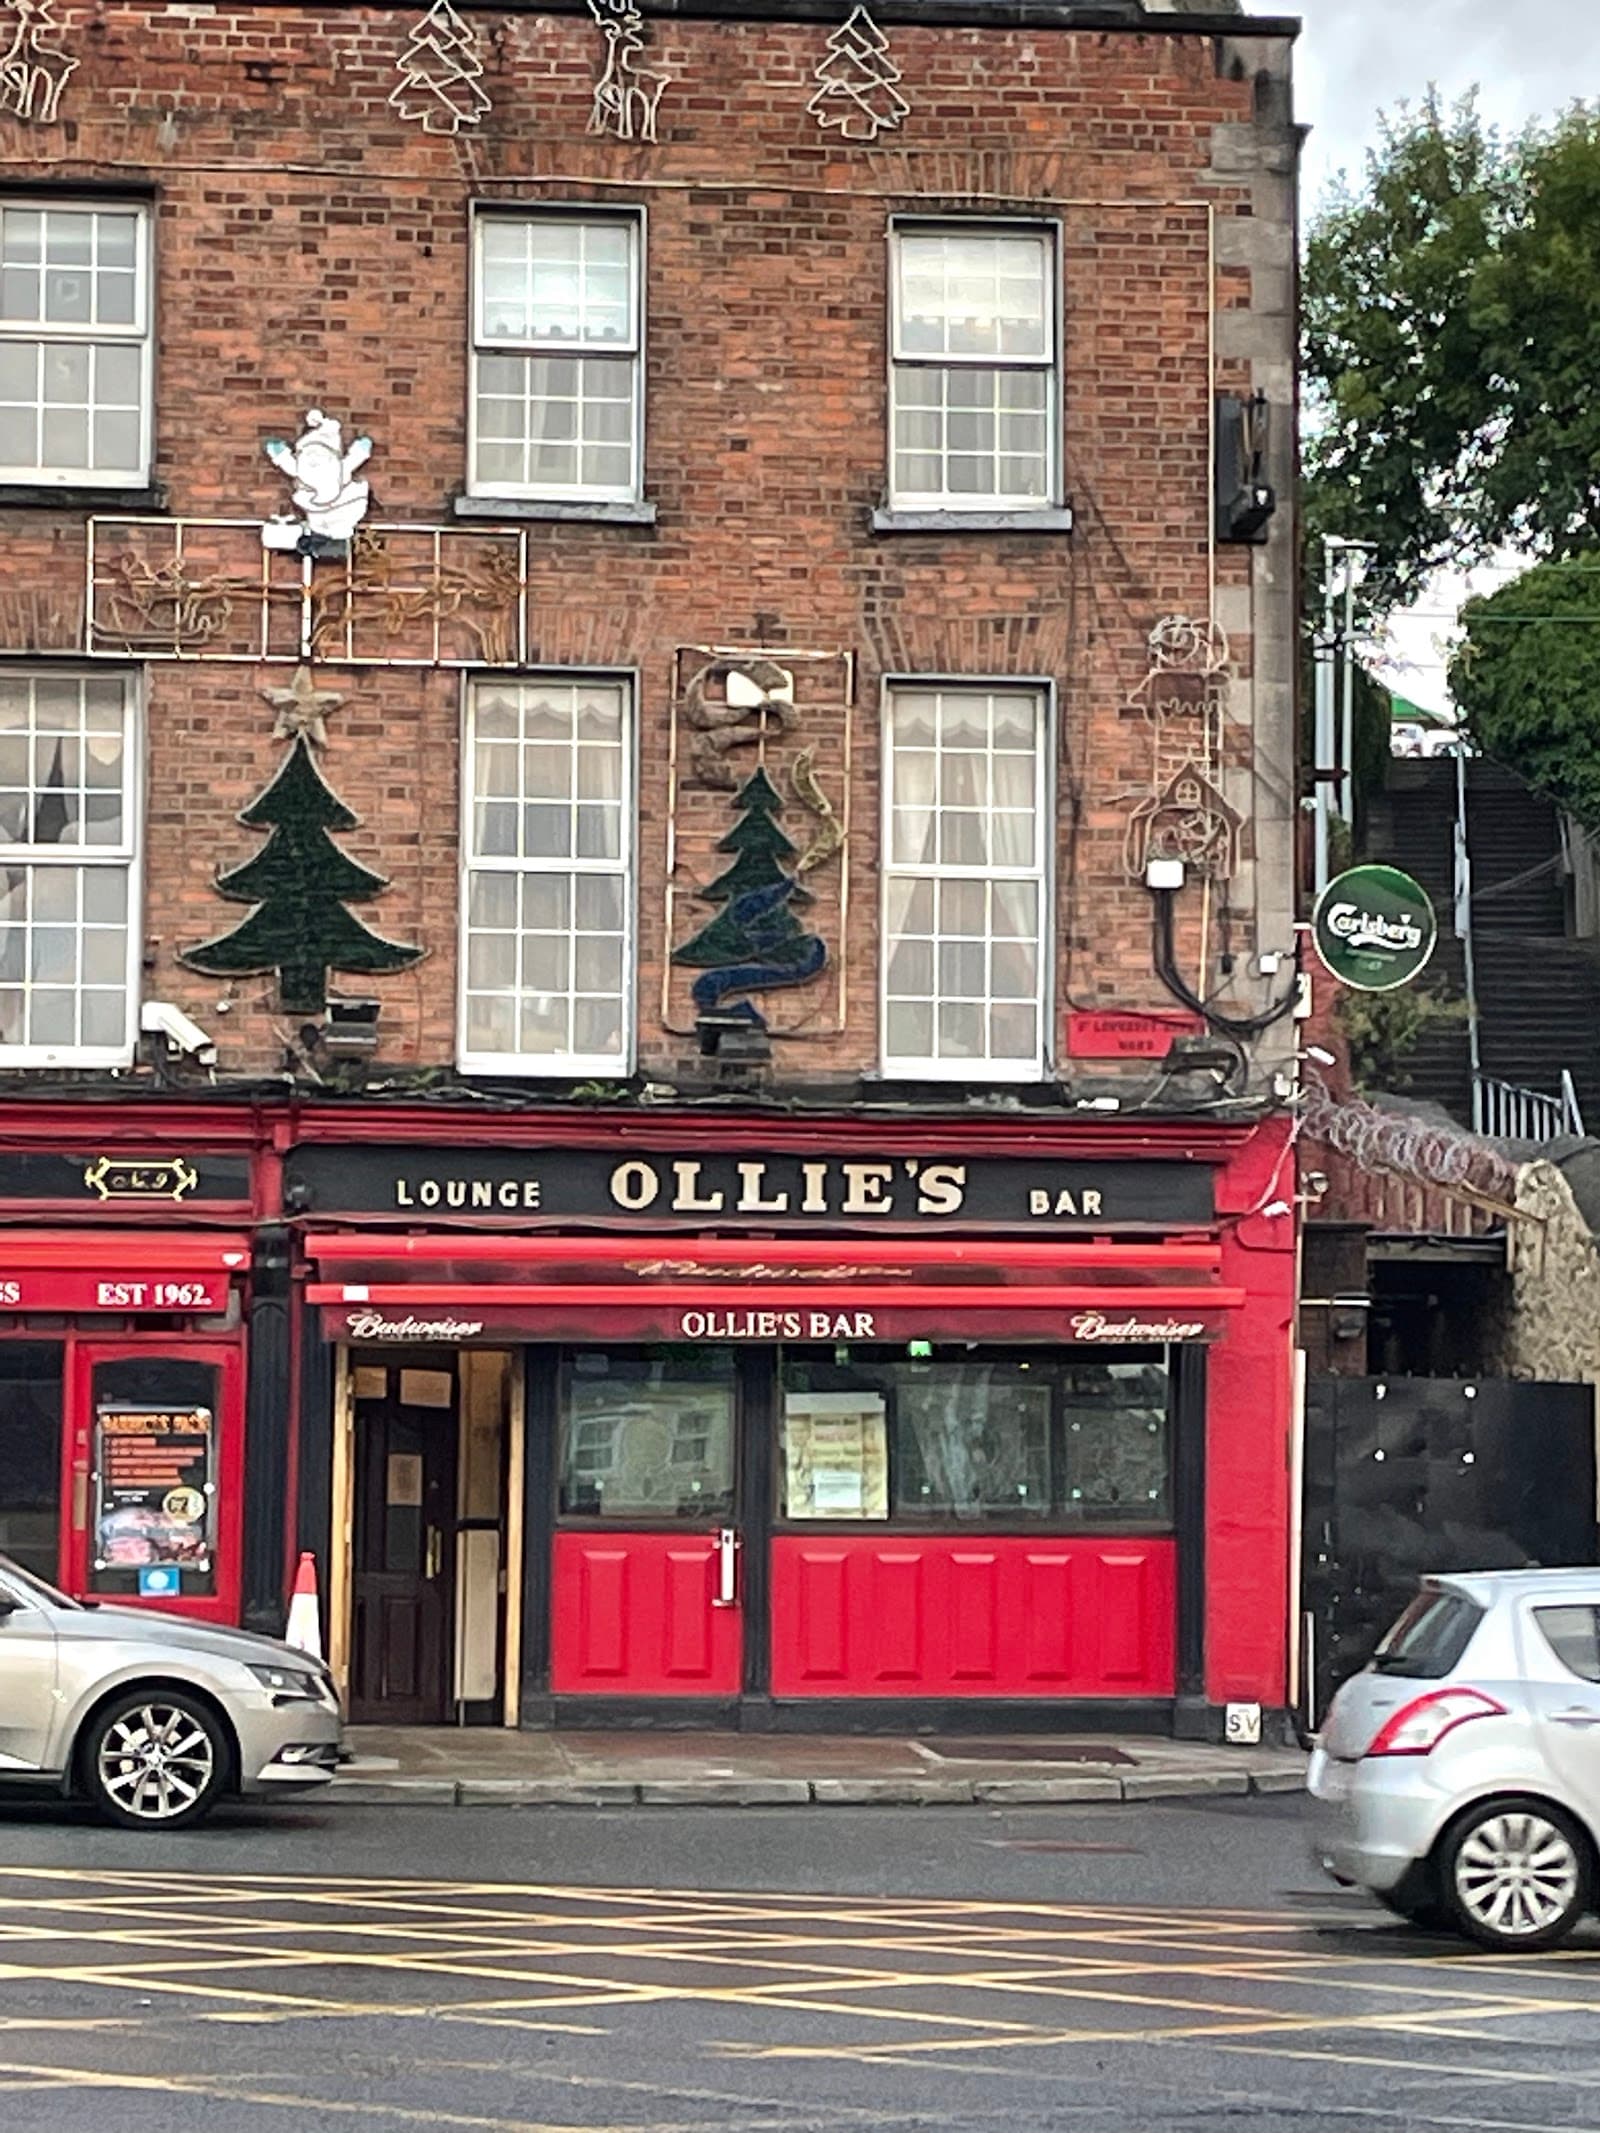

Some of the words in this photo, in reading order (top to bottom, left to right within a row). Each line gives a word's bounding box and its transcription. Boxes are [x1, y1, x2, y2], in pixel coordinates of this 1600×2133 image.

[1327, 902, 1422, 950] Carlsberg
[396, 1179, 541, 1208] LOUNGE
[610, 1159, 966, 1214] OLLIE'S
[1030, 1189, 1102, 1215] BAR
[0, 1281, 20, 1304] S
[97, 1282, 148, 1305] EST
[154, 1283, 213, 1306] 1962.
[346, 1312, 483, 1339] Budweiser
[681, 1311, 801, 1338] OLLIE'S
[810, 1312, 876, 1338] BAR
[1070, 1314, 1205, 1340] Budweiser
